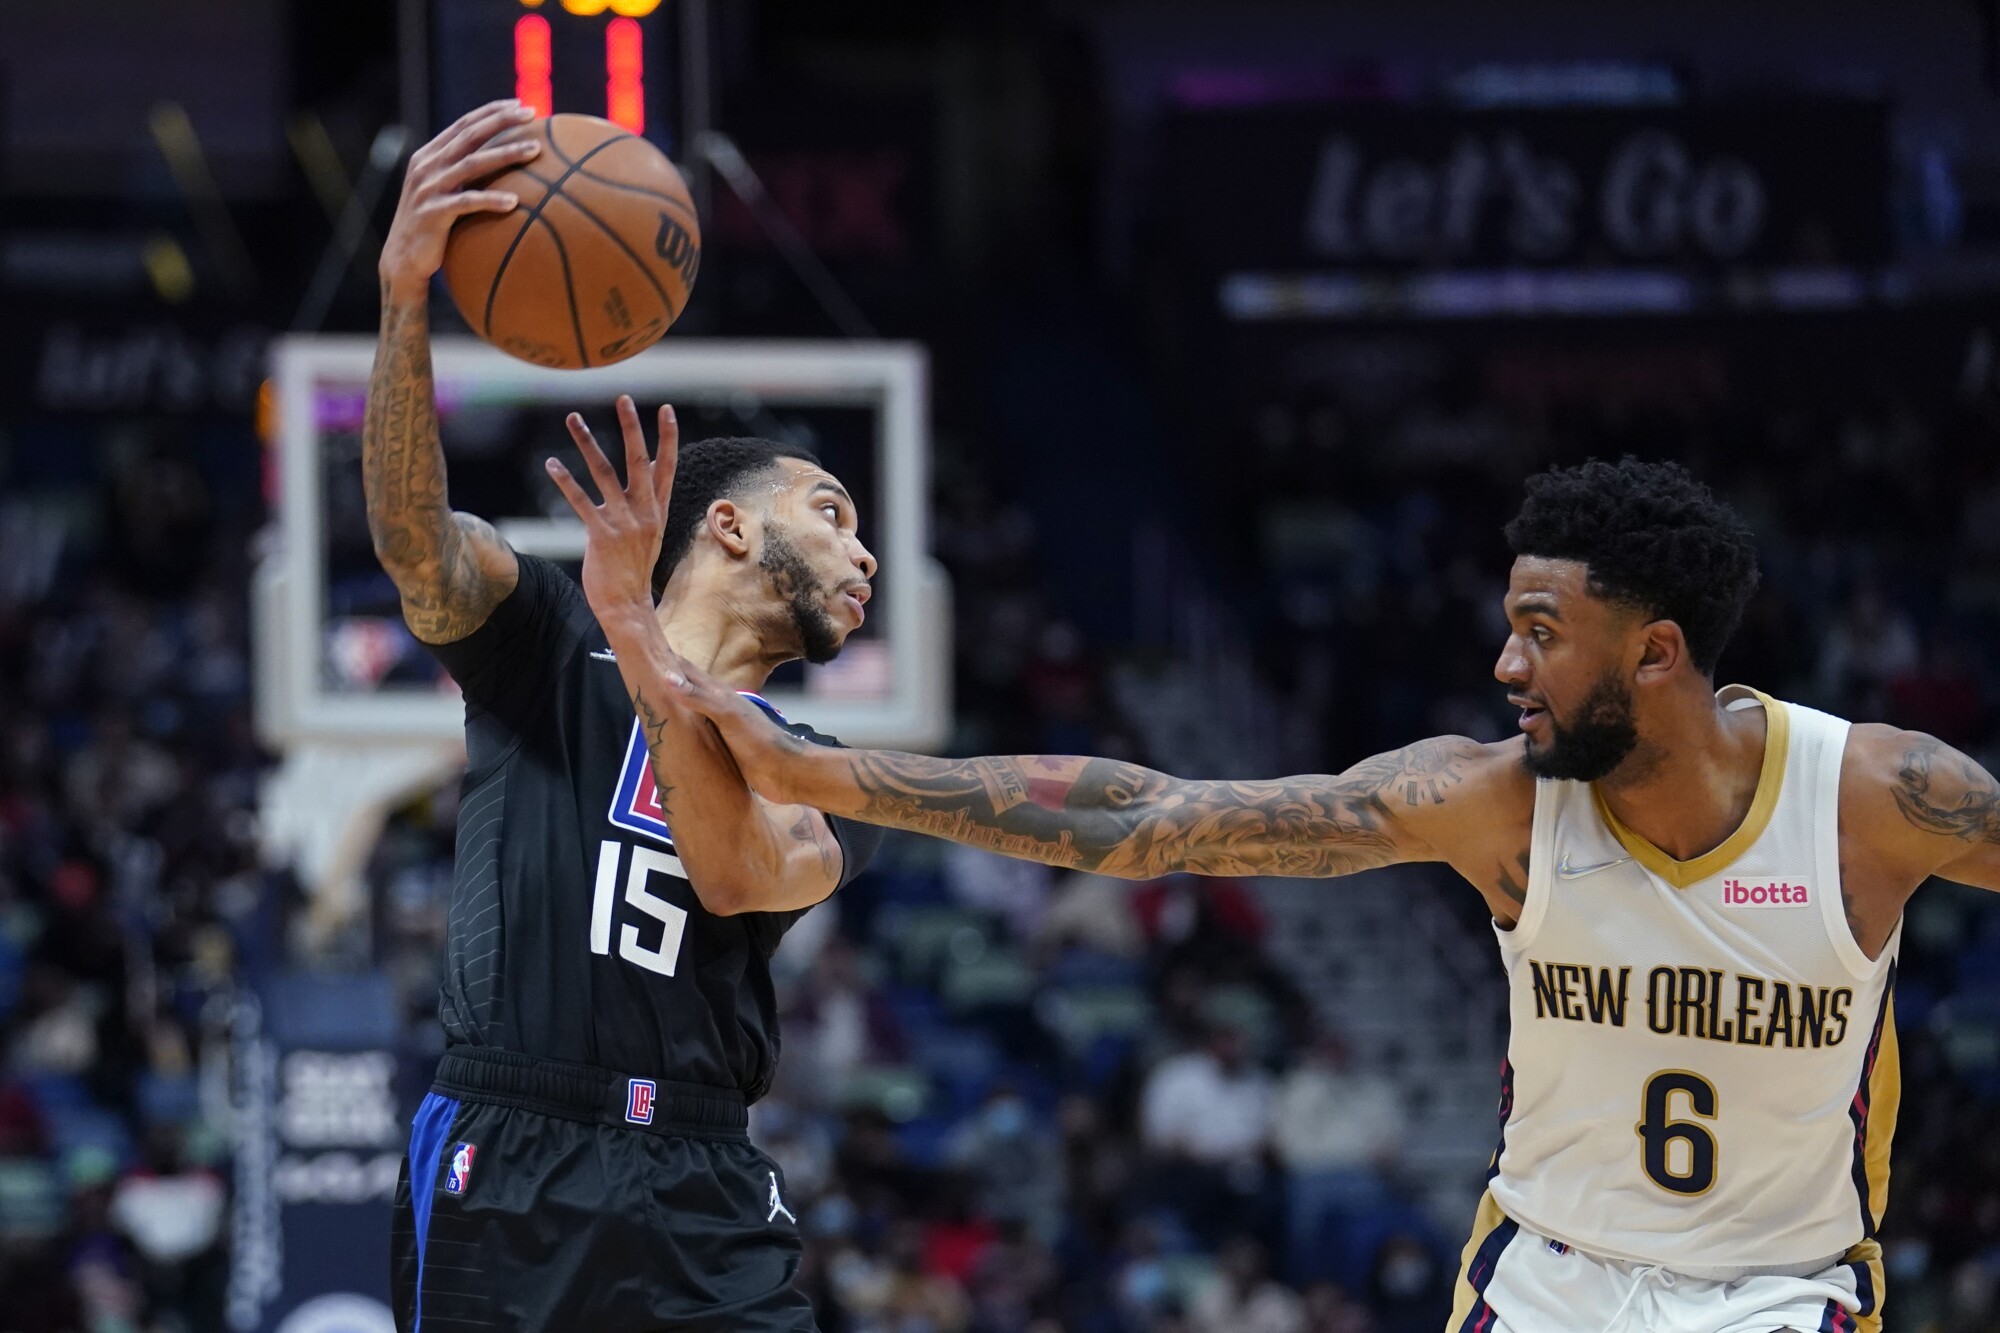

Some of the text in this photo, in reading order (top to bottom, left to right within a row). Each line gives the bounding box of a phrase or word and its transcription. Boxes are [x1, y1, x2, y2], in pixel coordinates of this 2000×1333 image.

[1307, 129, 1766, 256] Let's Go
[590, 840, 689, 977] 15
[1724, 880, 1808, 904] ibotta
[1529, 959, 1852, 1049] NEW ORLEANS
[1636, 1069, 1719, 1197] 6
